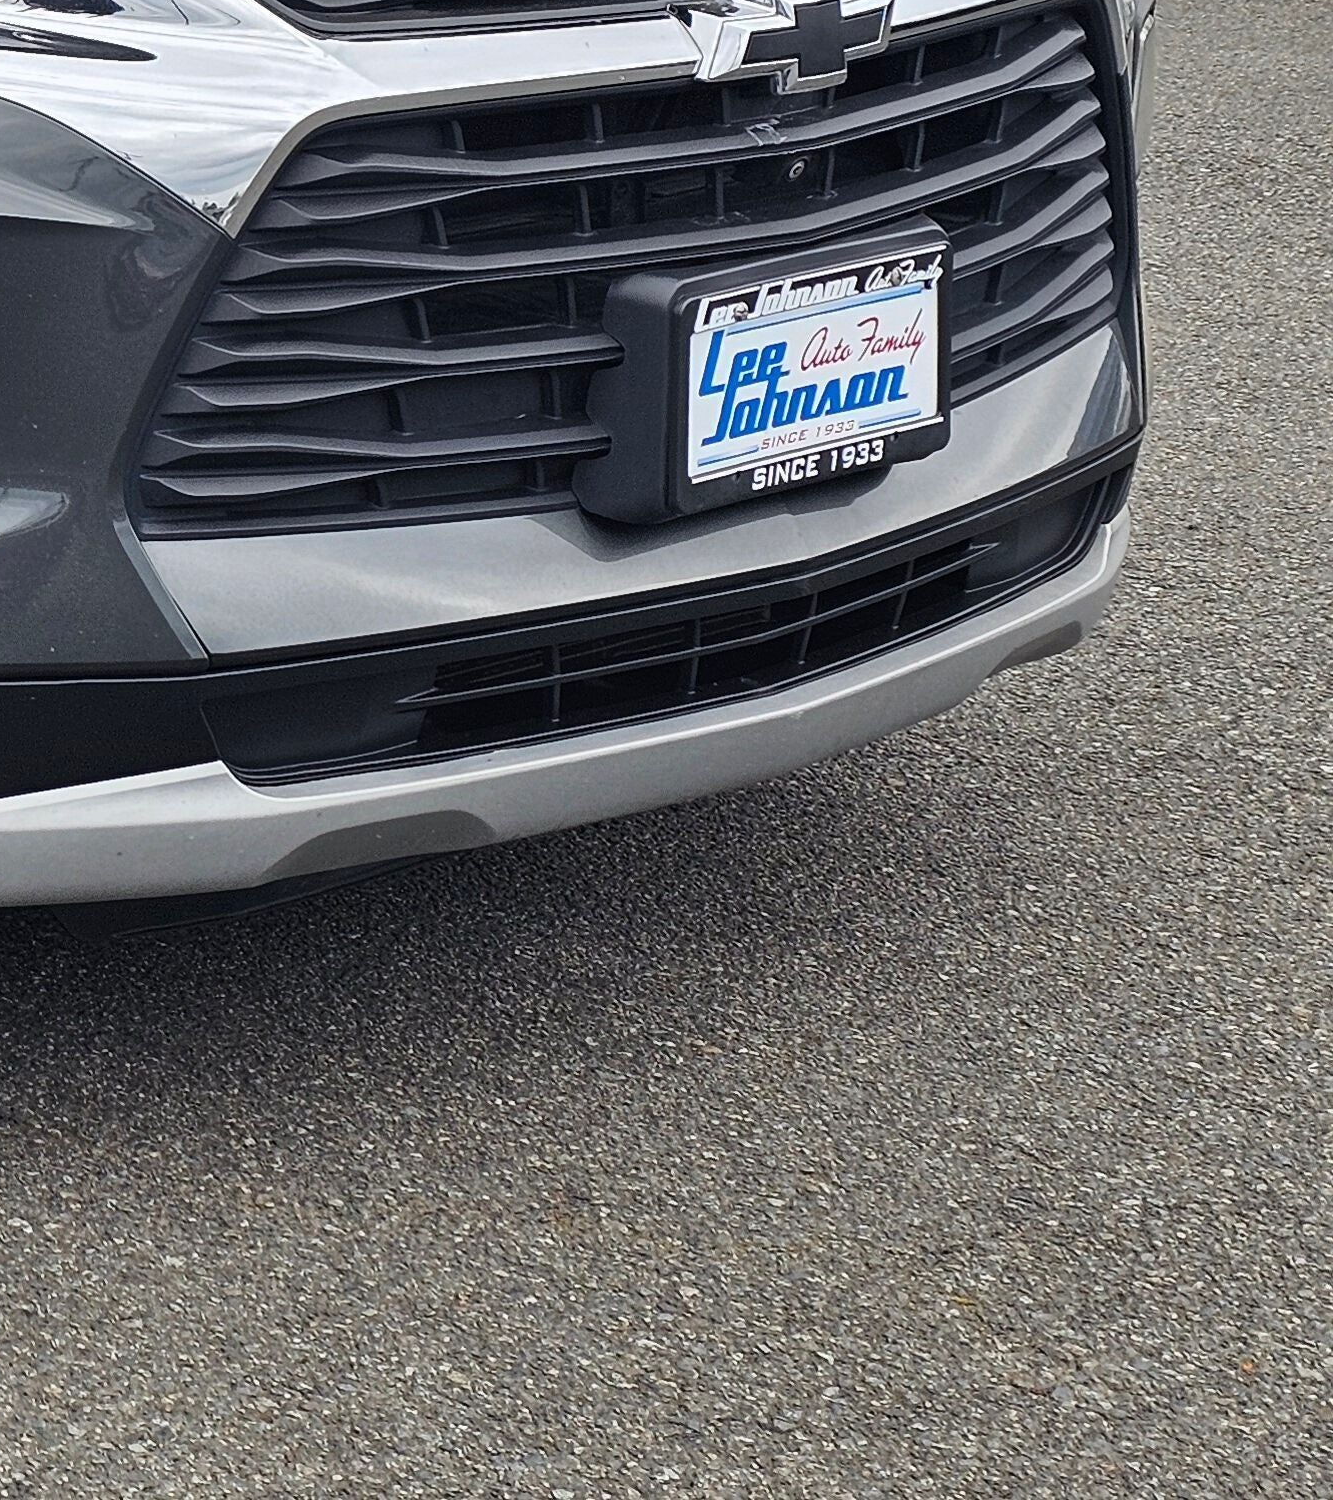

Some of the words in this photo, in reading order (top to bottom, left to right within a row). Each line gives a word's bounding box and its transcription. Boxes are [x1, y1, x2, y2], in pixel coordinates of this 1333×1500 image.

[747, 274, 860, 319] Johnson
[864, 265, 901, 293] Aut
[898, 253, 944, 288] Family
[698, 329, 791, 397] Lee
[800, 326, 853, 372] Auto
[857, 309, 927, 365] Family
[700, 365, 910, 447] Johnson
[760, 429, 808, 451] SINCE
[815, 419, 856, 438] 1933
[751, 453, 821, 491] SINCE
[830, 439, 885, 472] 1933
